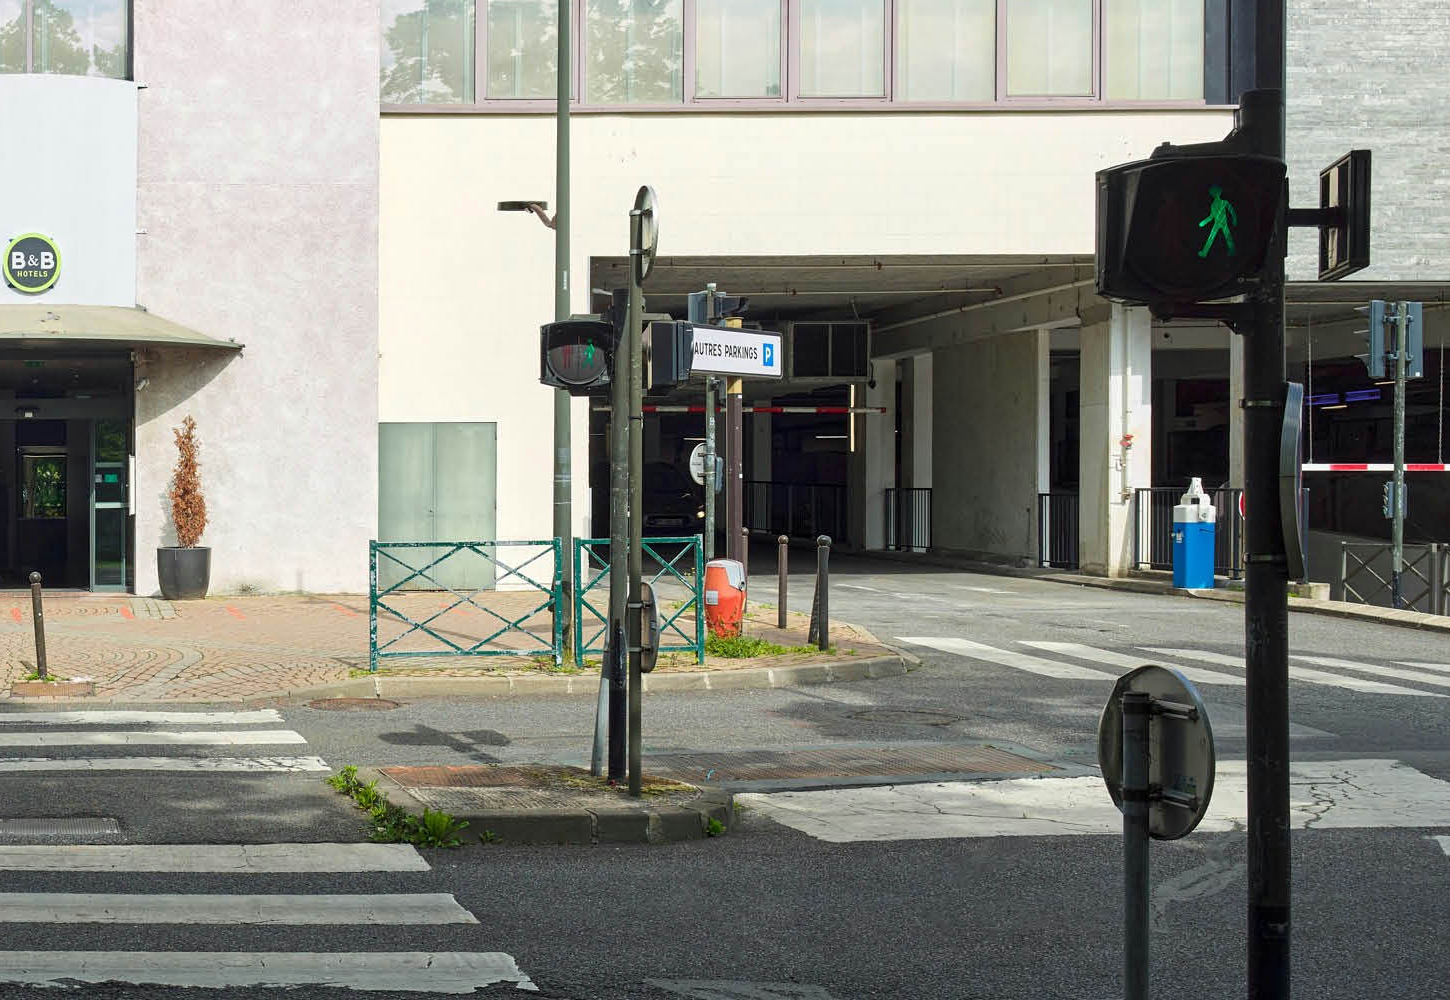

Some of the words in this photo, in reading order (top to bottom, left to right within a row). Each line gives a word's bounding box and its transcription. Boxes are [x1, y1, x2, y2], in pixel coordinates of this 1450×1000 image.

[11, 251, 55, 270] B&B
[17, 270, 48, 278] HOTELS
[694, 342, 722, 357] AUTRES
[724, 345, 758, 360] PARKINGS
